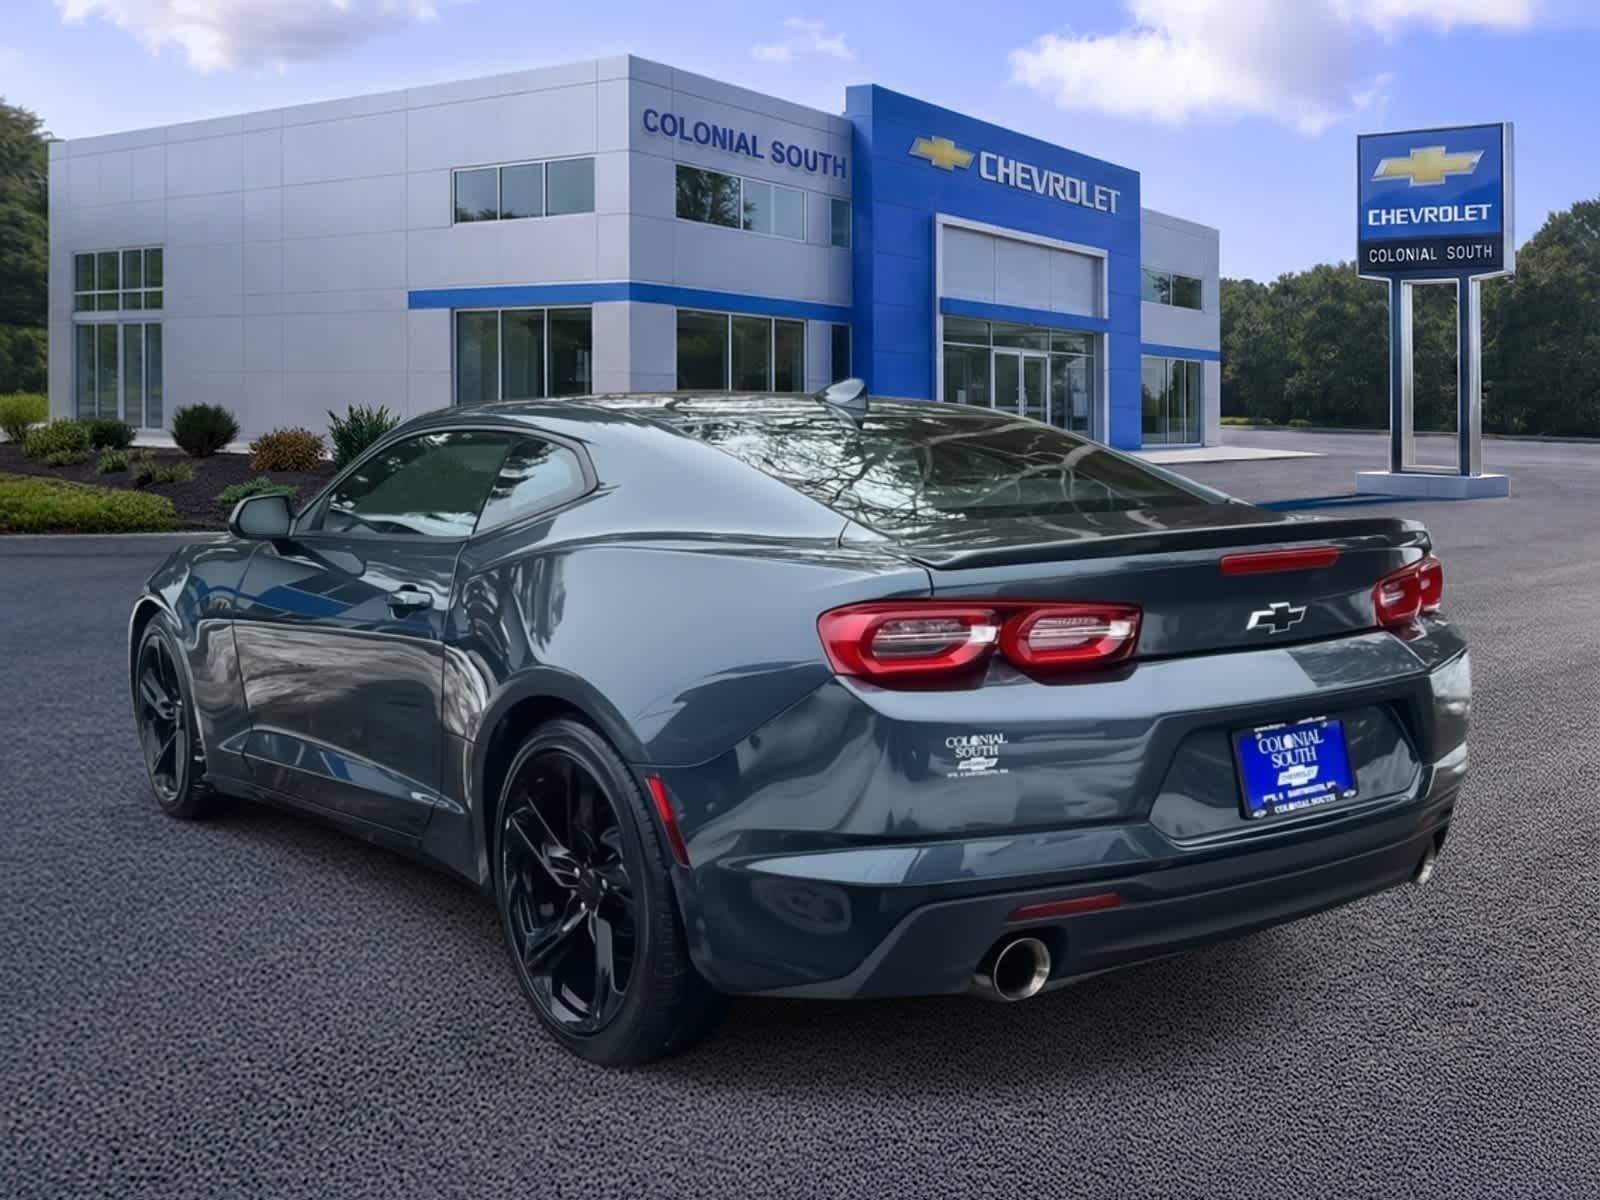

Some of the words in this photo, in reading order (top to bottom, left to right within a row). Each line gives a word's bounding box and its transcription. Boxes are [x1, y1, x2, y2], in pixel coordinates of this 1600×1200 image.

[643, 108, 764, 159] COLONIAL
[771, 140, 846, 178] SOUTH
[979, 150, 1120, 214] CHEVROLET
[1368, 204, 1492, 226] CHEVROLET
[1369, 248, 1437, 263] COLONIAL
[1447, 244, 1493, 260] SOUTH
[945, 733, 1008, 748] COLONIAL
[955, 744, 999, 758] SOUTH
[1259, 729, 1324, 754] COLONIAL
[1271, 746, 1318, 769] SOUTH
